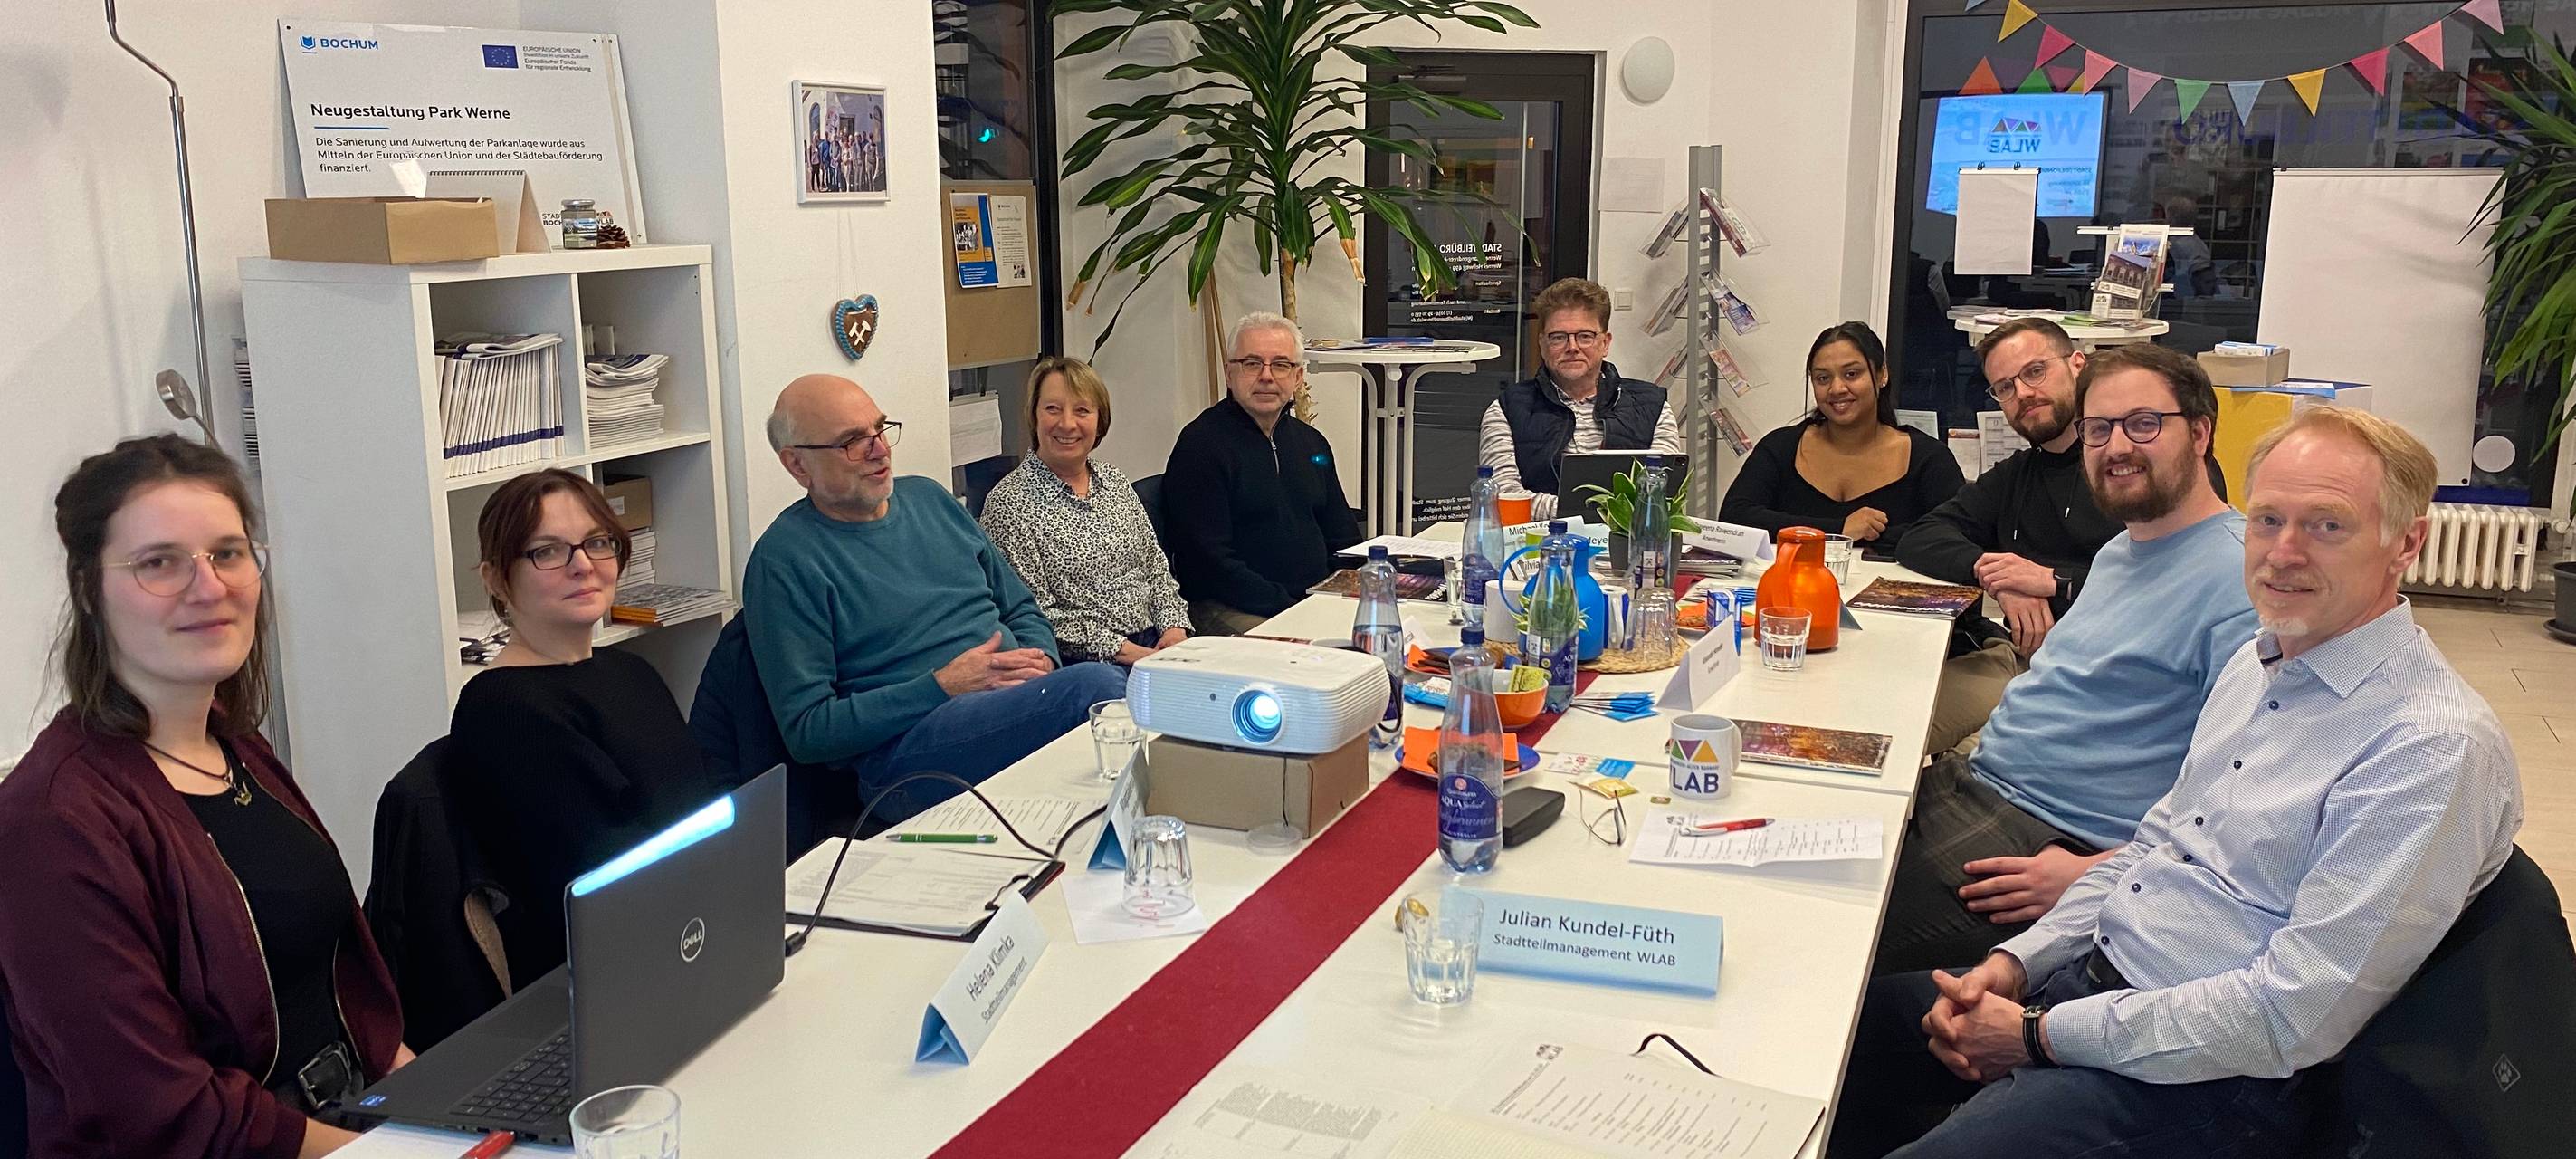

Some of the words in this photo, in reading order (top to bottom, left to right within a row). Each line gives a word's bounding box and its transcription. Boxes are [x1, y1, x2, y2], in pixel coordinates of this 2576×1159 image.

[320, 38, 379, 51] BOCHUM
[310, 103, 425, 120] Neugestaltung
[428, 106, 463, 119] Park
[464, 107, 510, 120] Werne
[316, 137, 333, 147] Die
[335, 138, 387, 148] Sanierung
[390, 138, 408, 147] und
[411, 139, 467, 148] Aufwertung
[469, 139, 485, 148] der
[487, 139, 539, 148] Parkanlage
[540, 139, 568, 148] wurde
[318, 150, 354, 159] Mitteln
[357, 150, 373, 159] der
[377, 151, 443, 161] Europäischen
[444, 151, 473, 159] Union
[475, 151, 494, 159] und
[496, 151, 511, 160] der
[513, 151, 603, 161] Städtebauförderung
[320, 163, 372, 172] finanziert.
[1671, 765, 1719, 794] LAB
[1499, 909, 1552, 929] Julian
[1558, 915, 1674, 944] Kundel-Füth
[683, 929, 702, 950] DELL
[1493, 934, 1632, 962] Stadtteilmanagement
[1636, 950, 1676, 966] WLAB
[966, 963, 996, 1001] Helena
